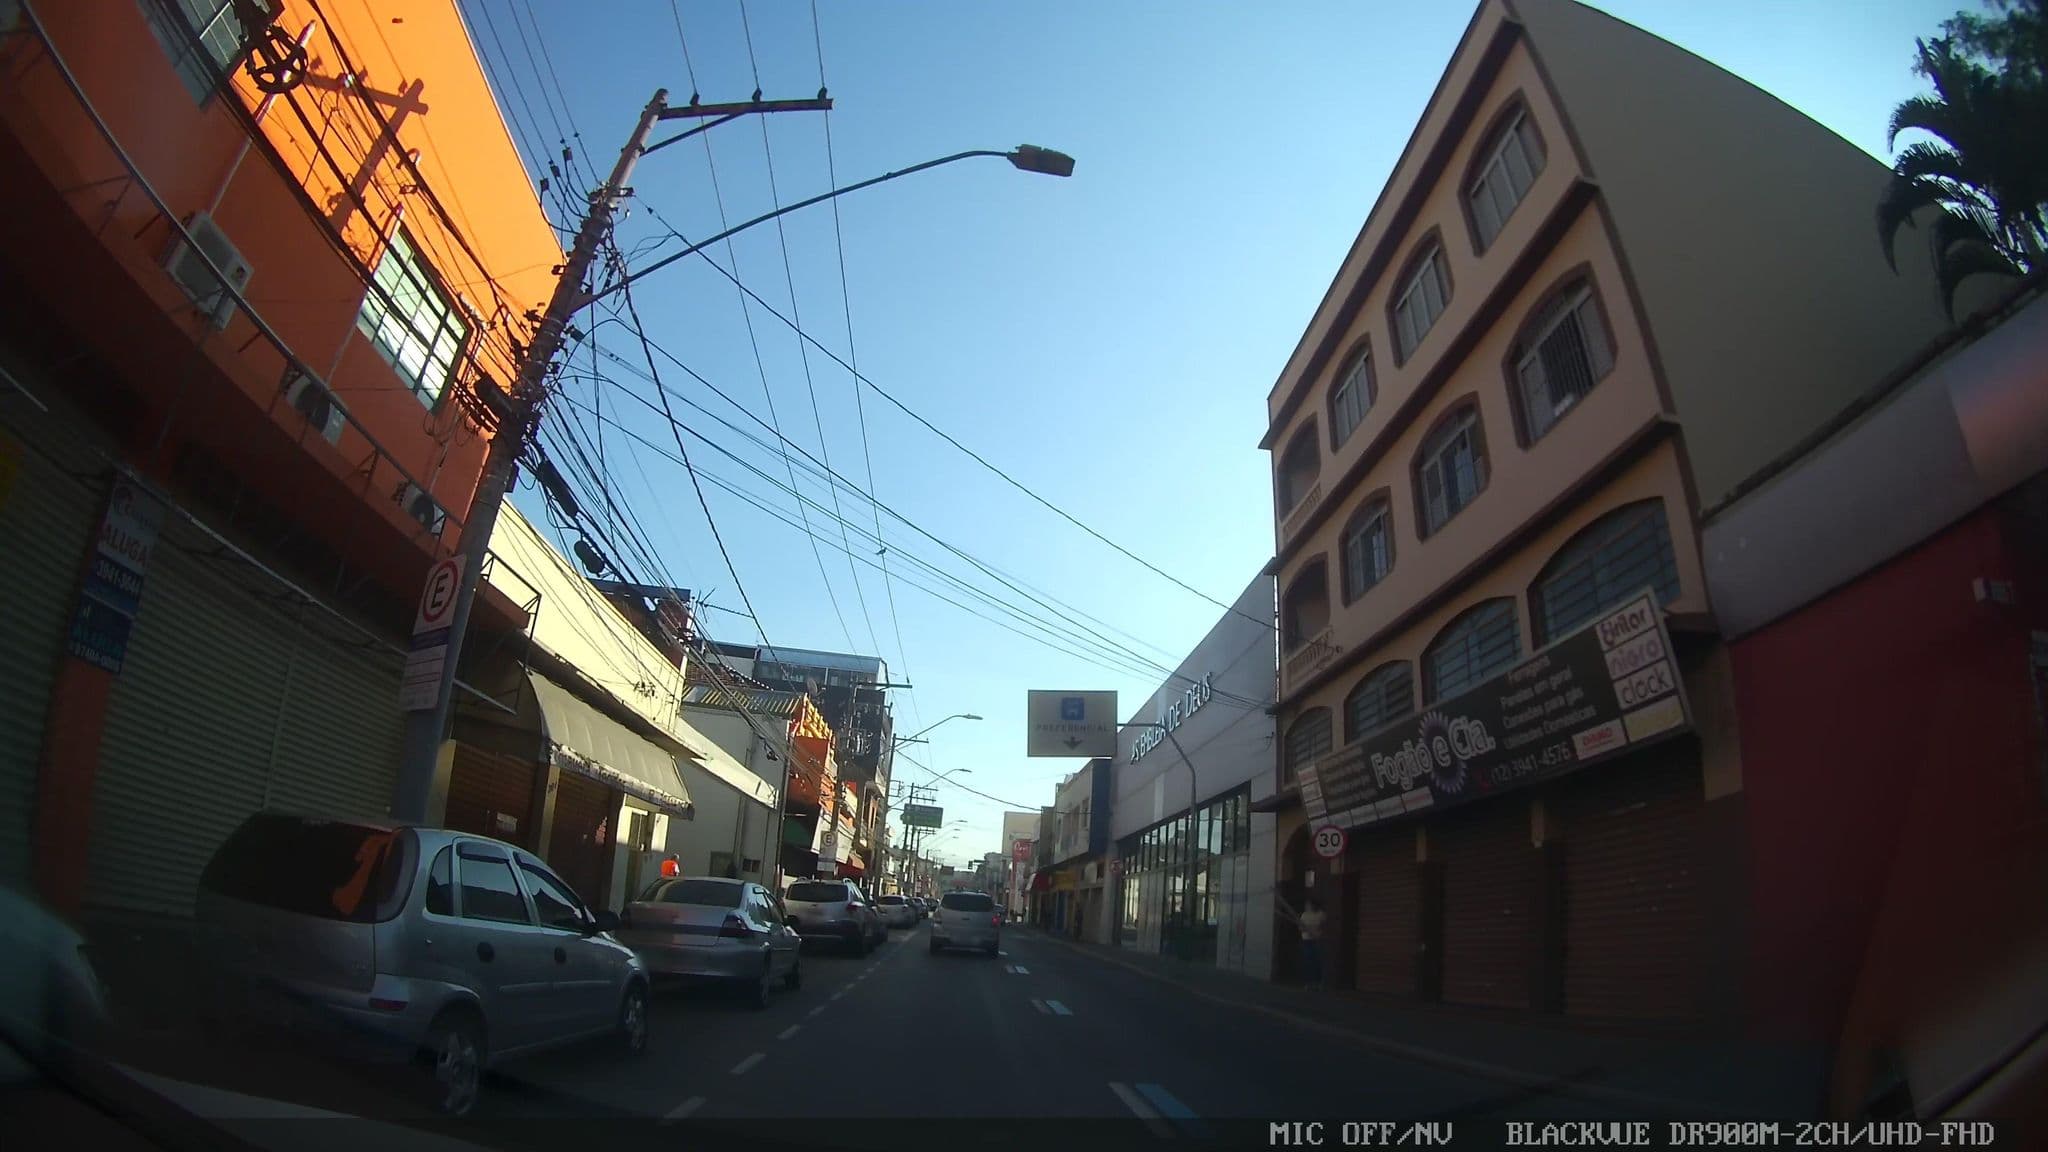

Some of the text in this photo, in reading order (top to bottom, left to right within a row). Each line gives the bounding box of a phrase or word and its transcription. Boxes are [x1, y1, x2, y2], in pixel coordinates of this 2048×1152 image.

[430, 572, 449, 609] E
[1621, 665, 1671, 705] clock
[1168, 699, 1182, 732] DE
[1371, 738, 1433, 791] Fogão
[1432, 735, 1452, 768] e
[1319, 832, 1341, 848] 30
